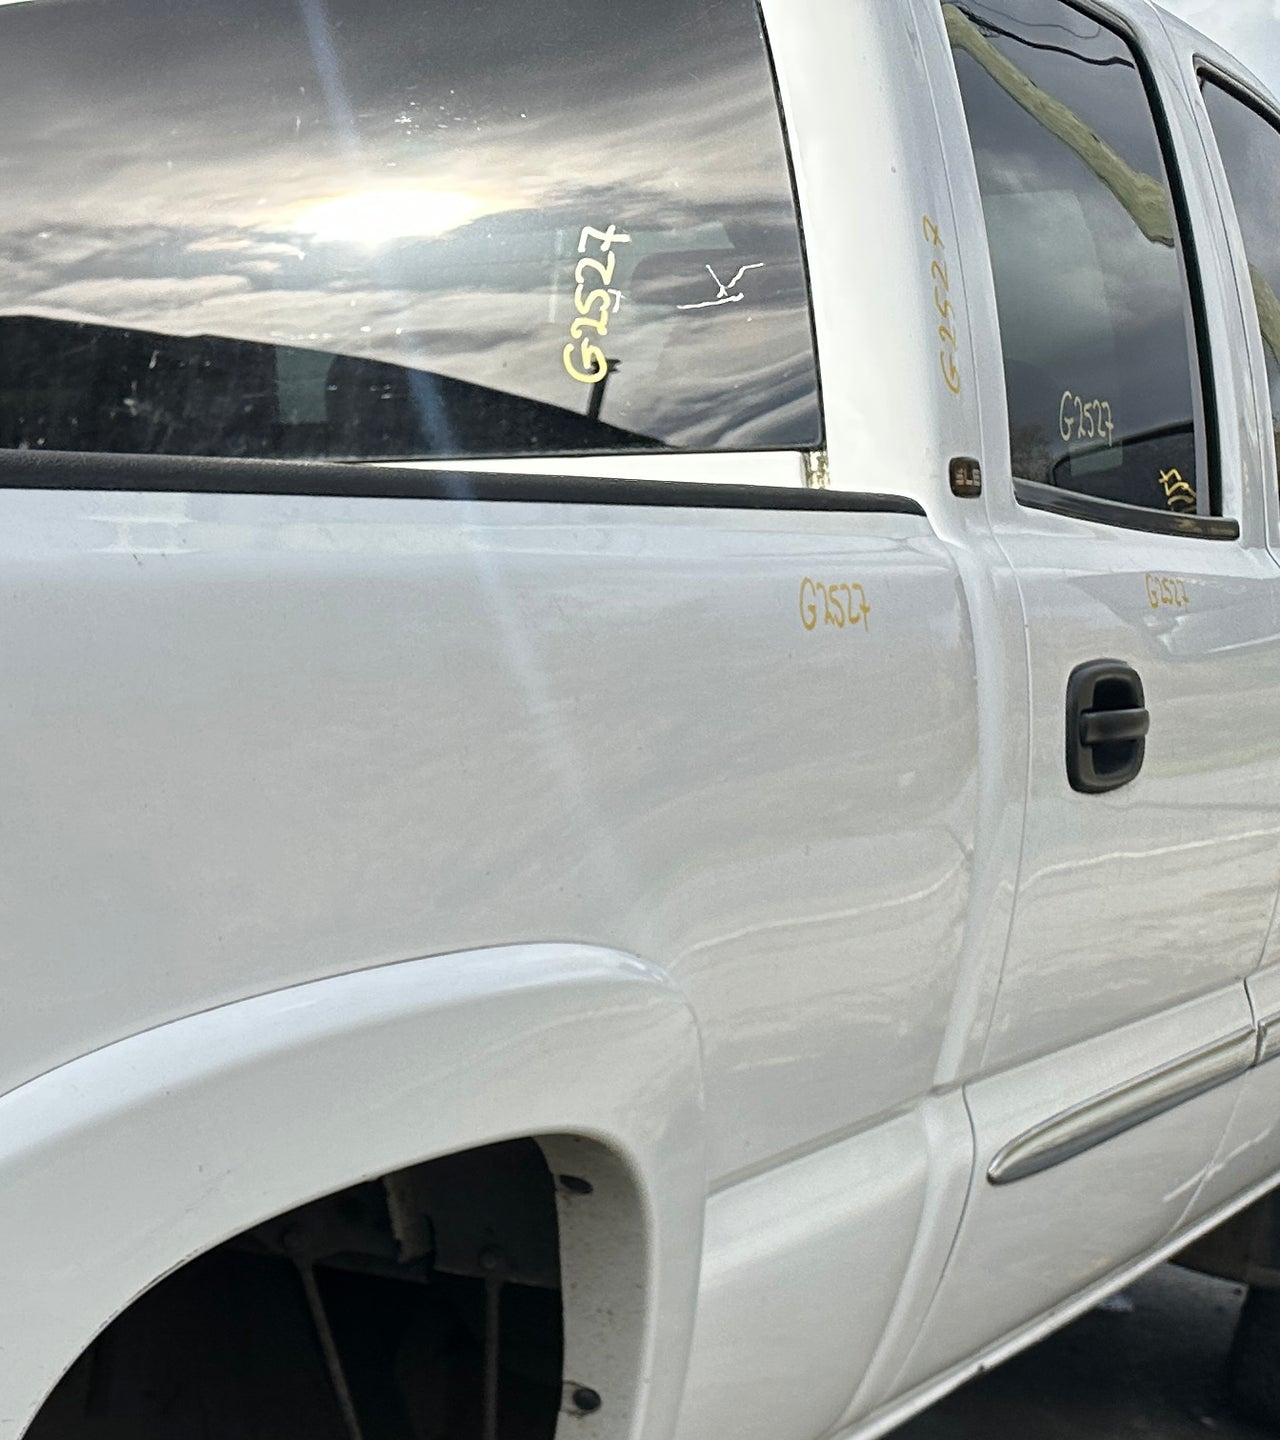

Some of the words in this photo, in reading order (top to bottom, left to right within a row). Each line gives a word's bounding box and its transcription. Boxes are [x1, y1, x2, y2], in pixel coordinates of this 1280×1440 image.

[563, 224, 632, 383] G2527
[922, 214, 961, 395] G2527
[1059, 390, 1114, 447] G2527
[799, 577, 871, 632] G2527
